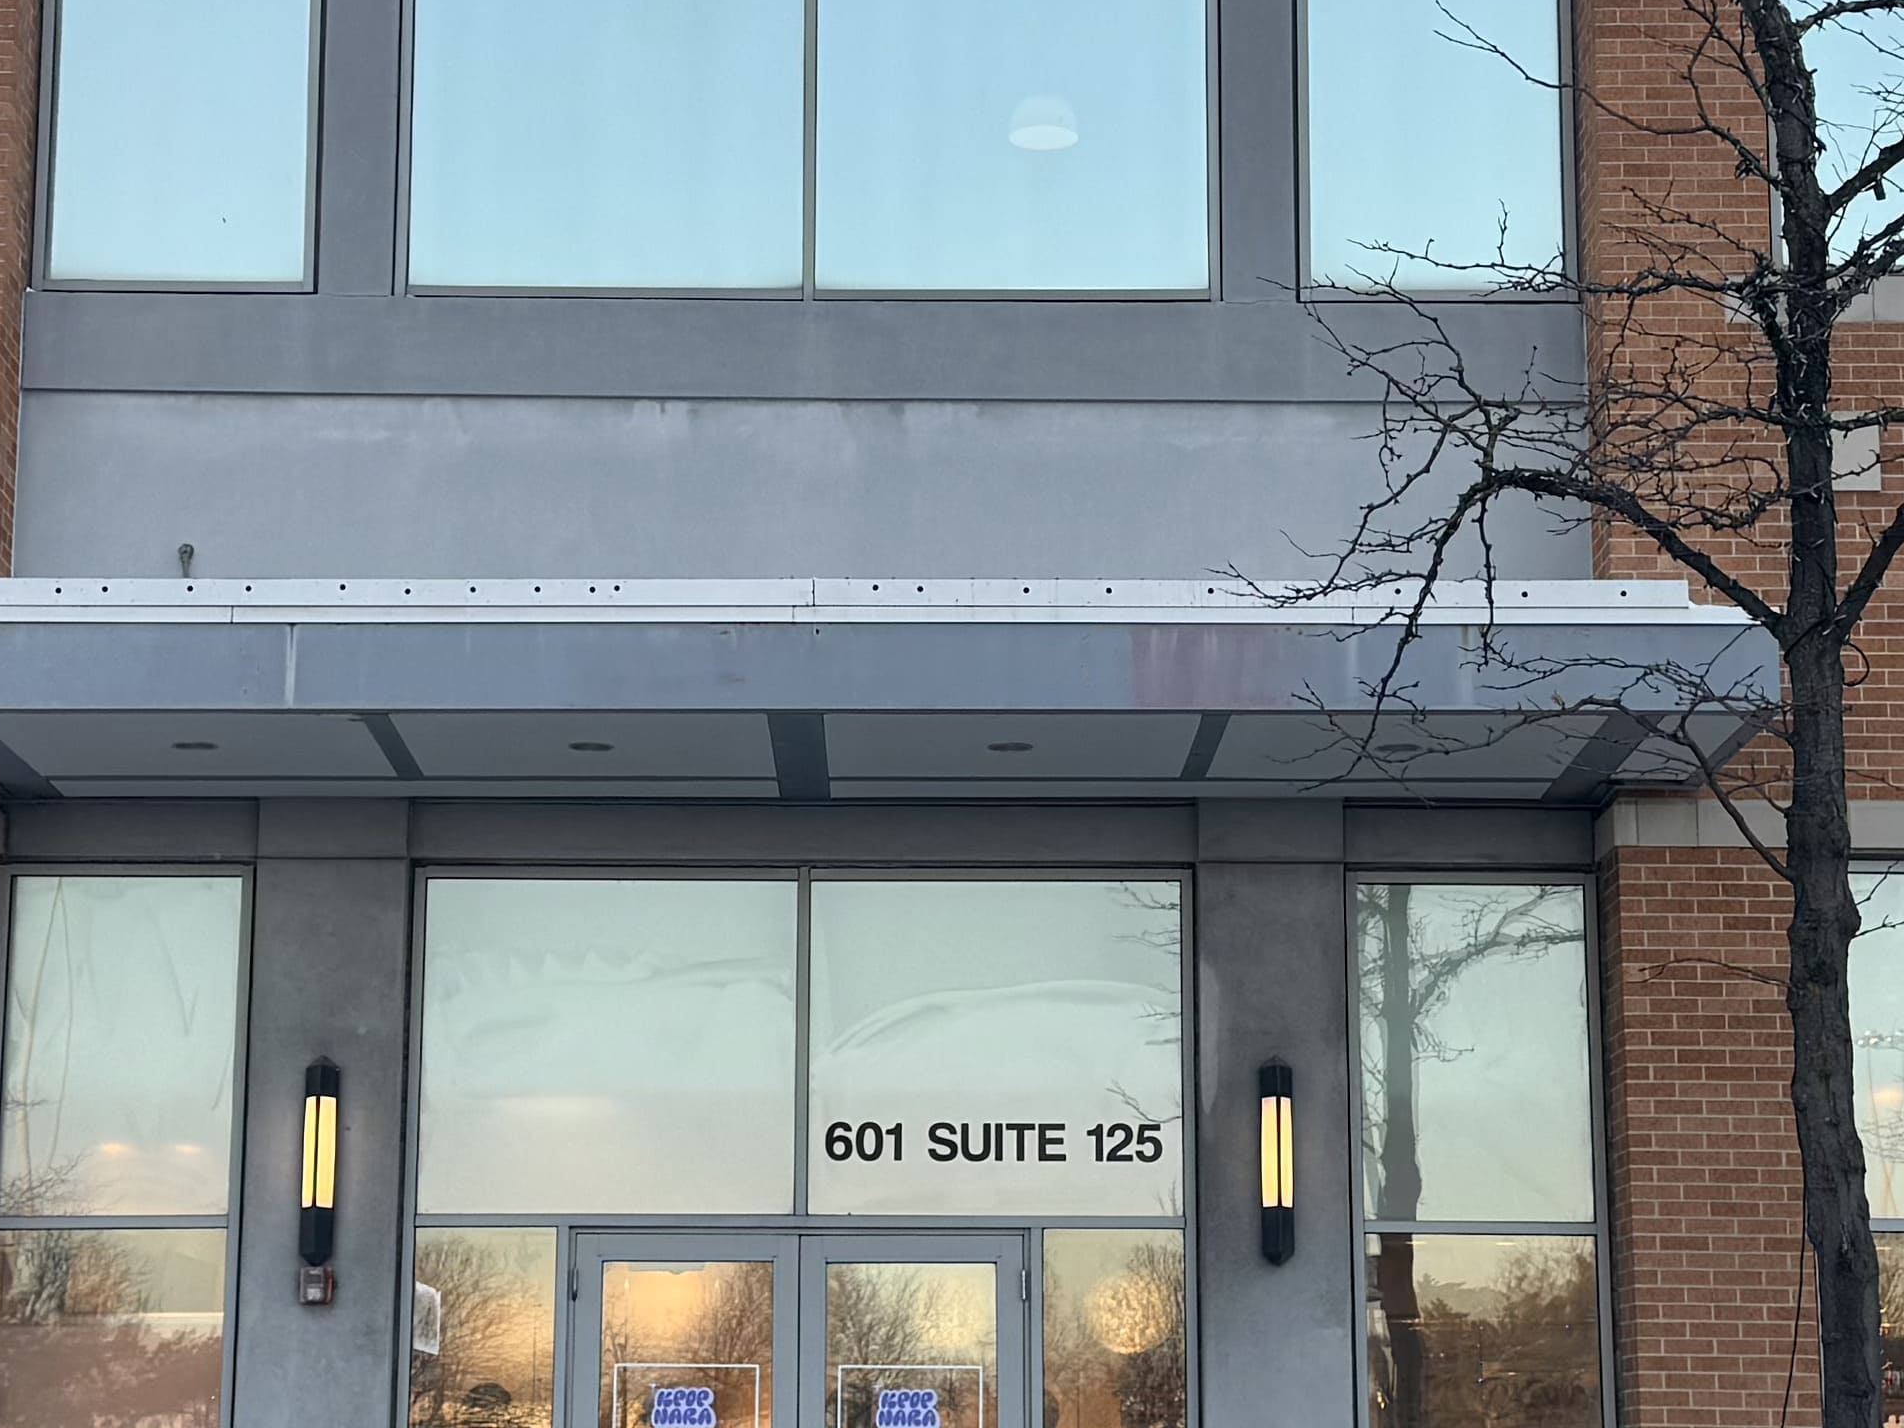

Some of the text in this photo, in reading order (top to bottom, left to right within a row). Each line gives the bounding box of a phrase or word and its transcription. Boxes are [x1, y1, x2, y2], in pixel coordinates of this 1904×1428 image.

[825, 1122, 1163, 1163] 601 SUITE 125
[657, 1390, 709, 1408] KPOP
[881, 1392, 933, 1409] KPOP
[654, 1408, 712, 1425] NARA
[878, 1409, 936, 1427] NARA
